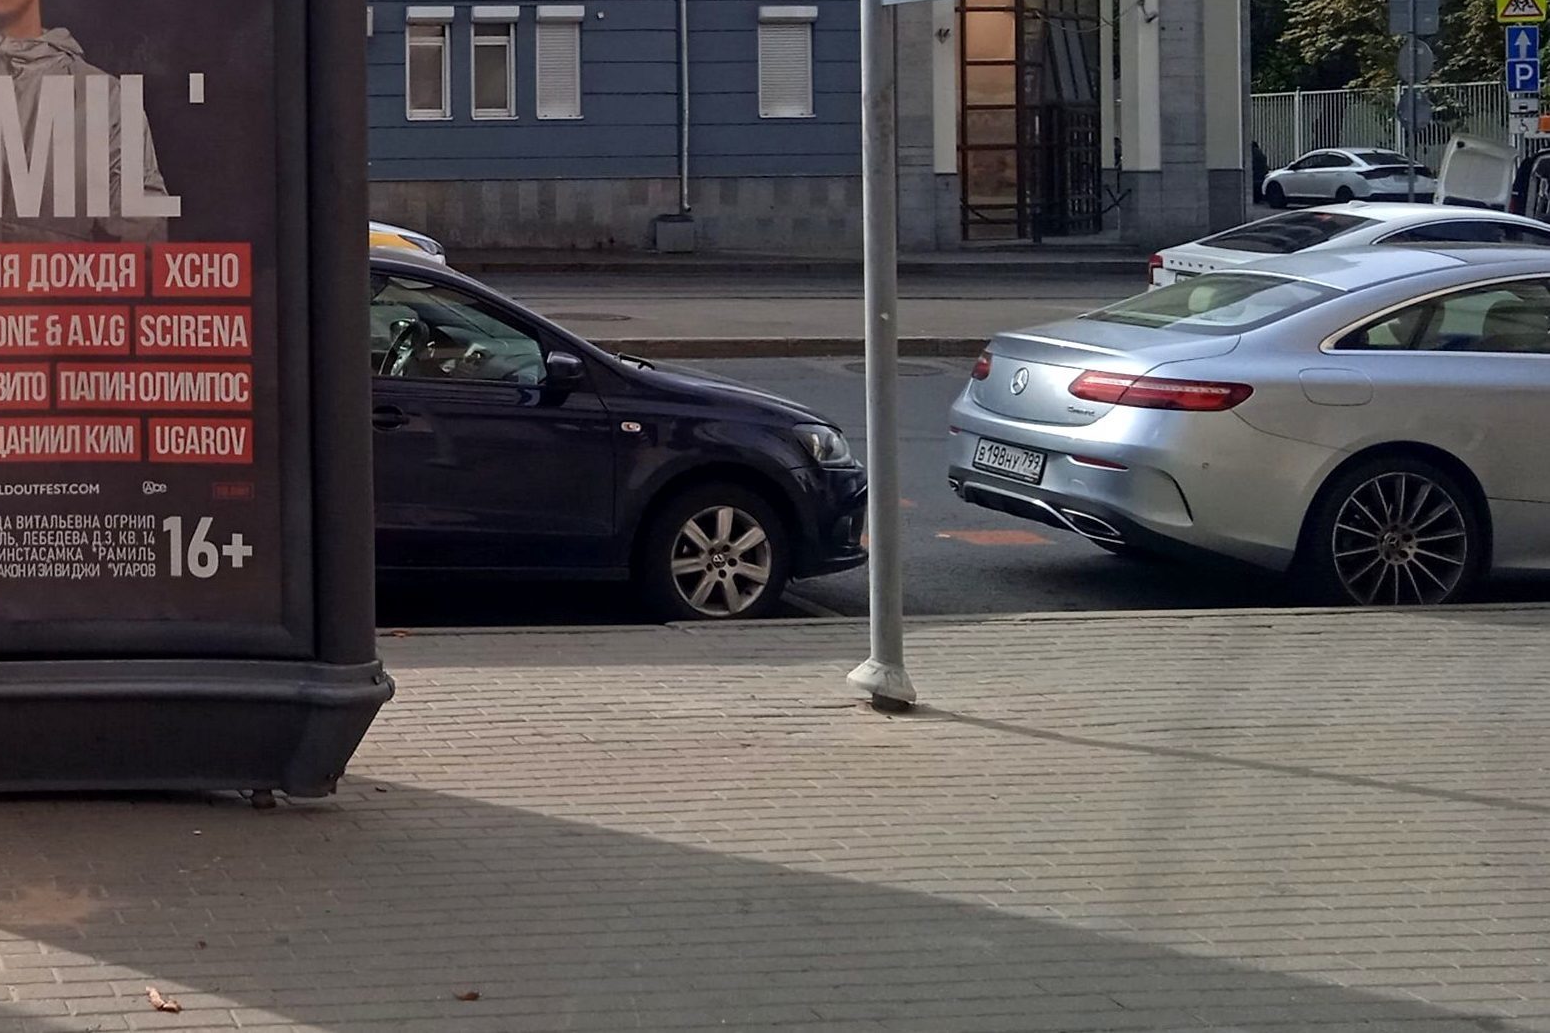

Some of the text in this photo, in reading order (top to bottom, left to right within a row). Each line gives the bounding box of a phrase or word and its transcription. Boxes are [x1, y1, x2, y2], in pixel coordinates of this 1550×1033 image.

[27, 253, 136, 292] ДОЖДЯ
[45, 315, 62, 346] &
[67, 315, 126, 347] A.V.G
[140, 314, 248, 348] SCIRENA
[60, 371, 249, 403] ПАПИН ОЛИМПОС
[84, 425, 135, 455] КИМ
[155, 426, 246, 456] UGAROV
[16, 514, 101, 529] ВИТАЛЬЕВНА
[104, 514, 155, 529] ОГРНИП
[23, 531, 88, 547] ЛЕБЕДЕВА
[143, 531, 155, 545] 14
[163, 516, 253, 578] 16+
